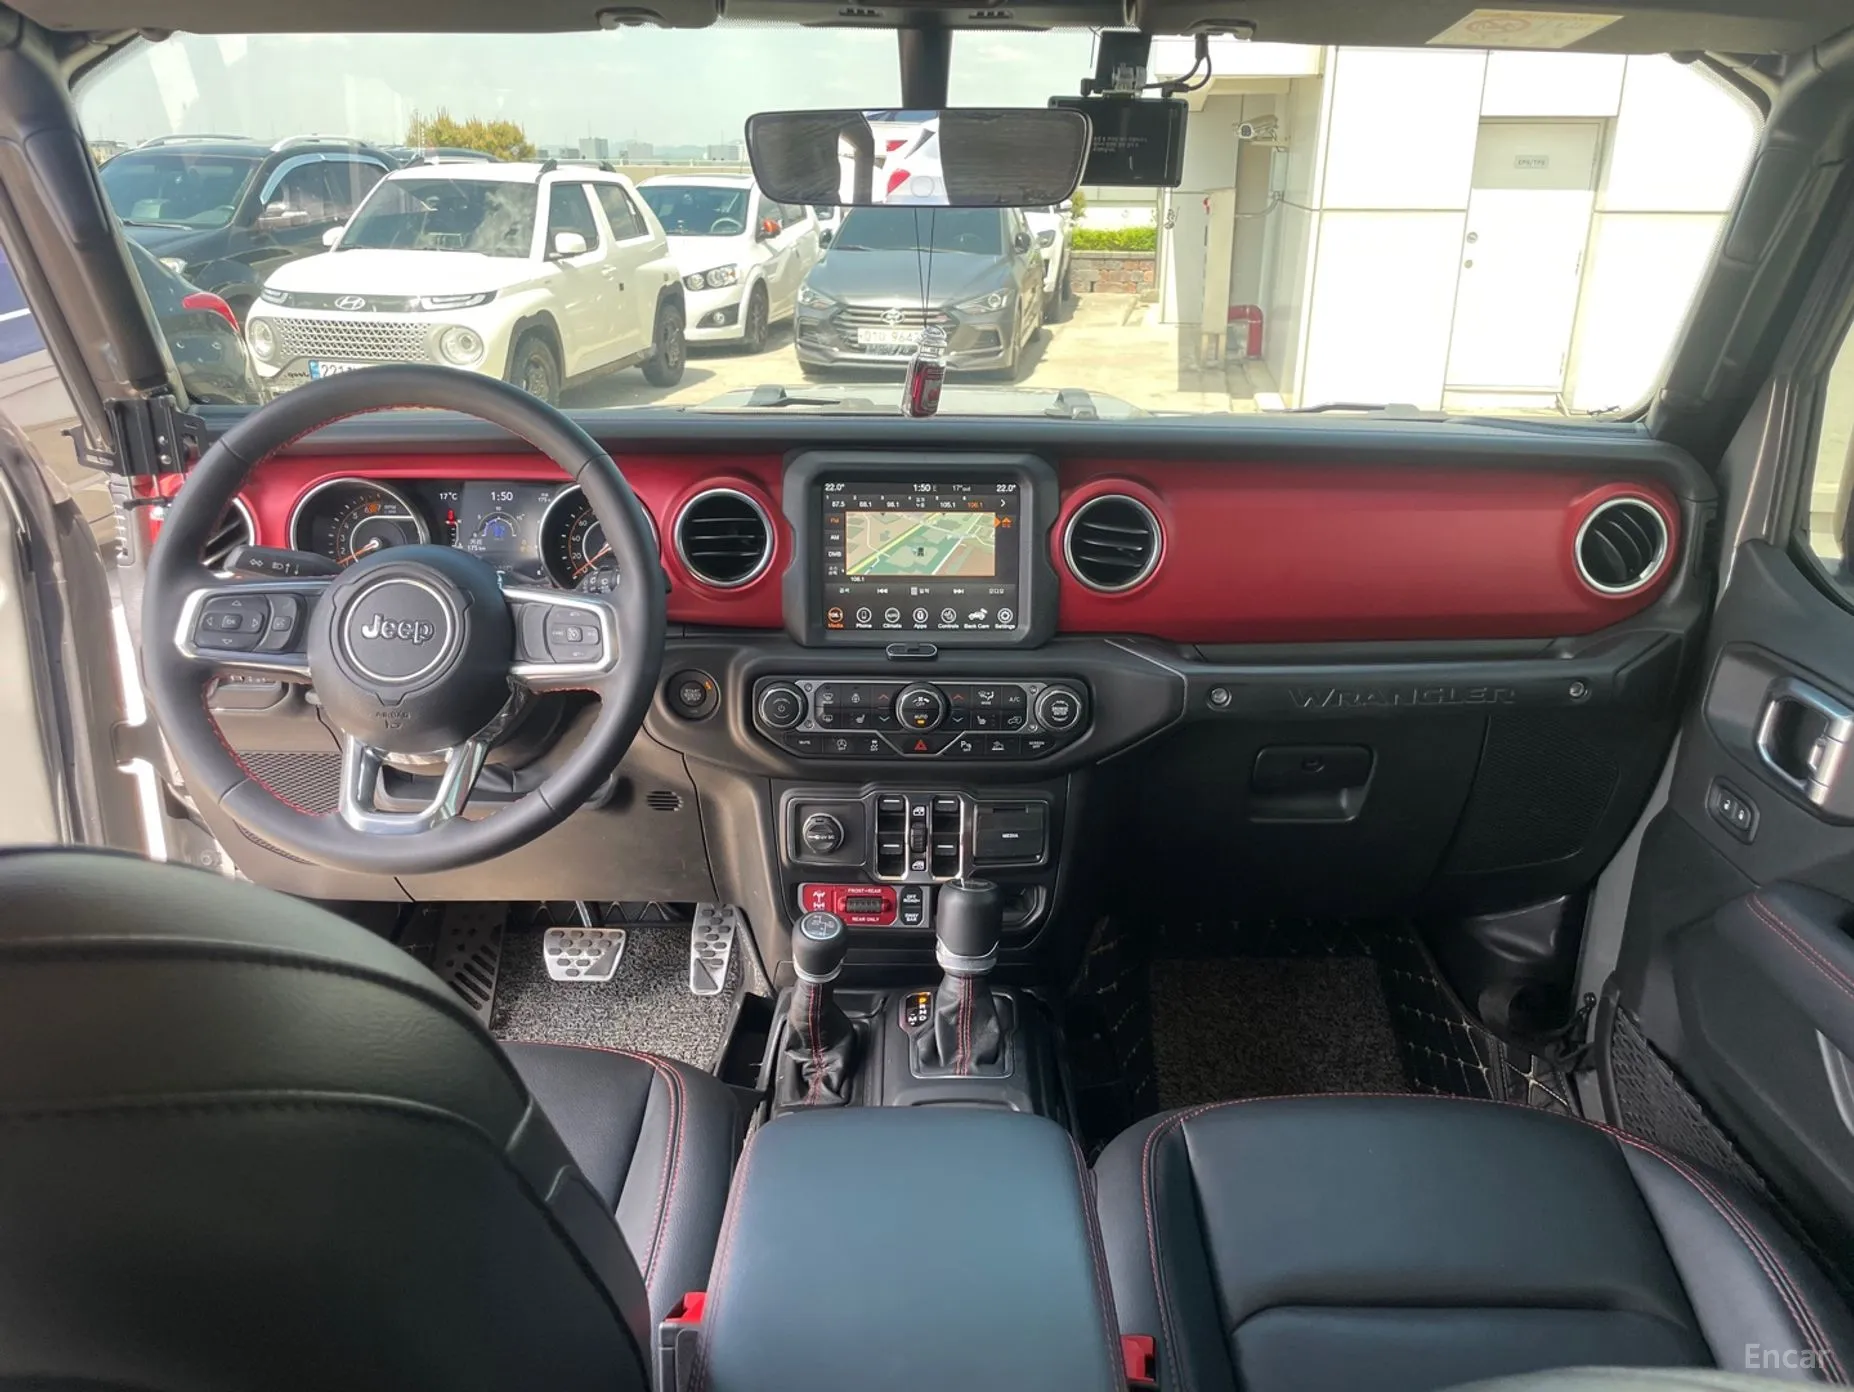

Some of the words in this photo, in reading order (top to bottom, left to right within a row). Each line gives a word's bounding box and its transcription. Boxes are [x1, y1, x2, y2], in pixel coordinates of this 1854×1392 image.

[913, 484, 931, 492] 1:50
[491, 491, 514, 501] 1:50
[572, 552, 582, 560] 20
[361, 613, 435, 645] Jeep
[1289, 687, 1516, 708] WRANGLER
